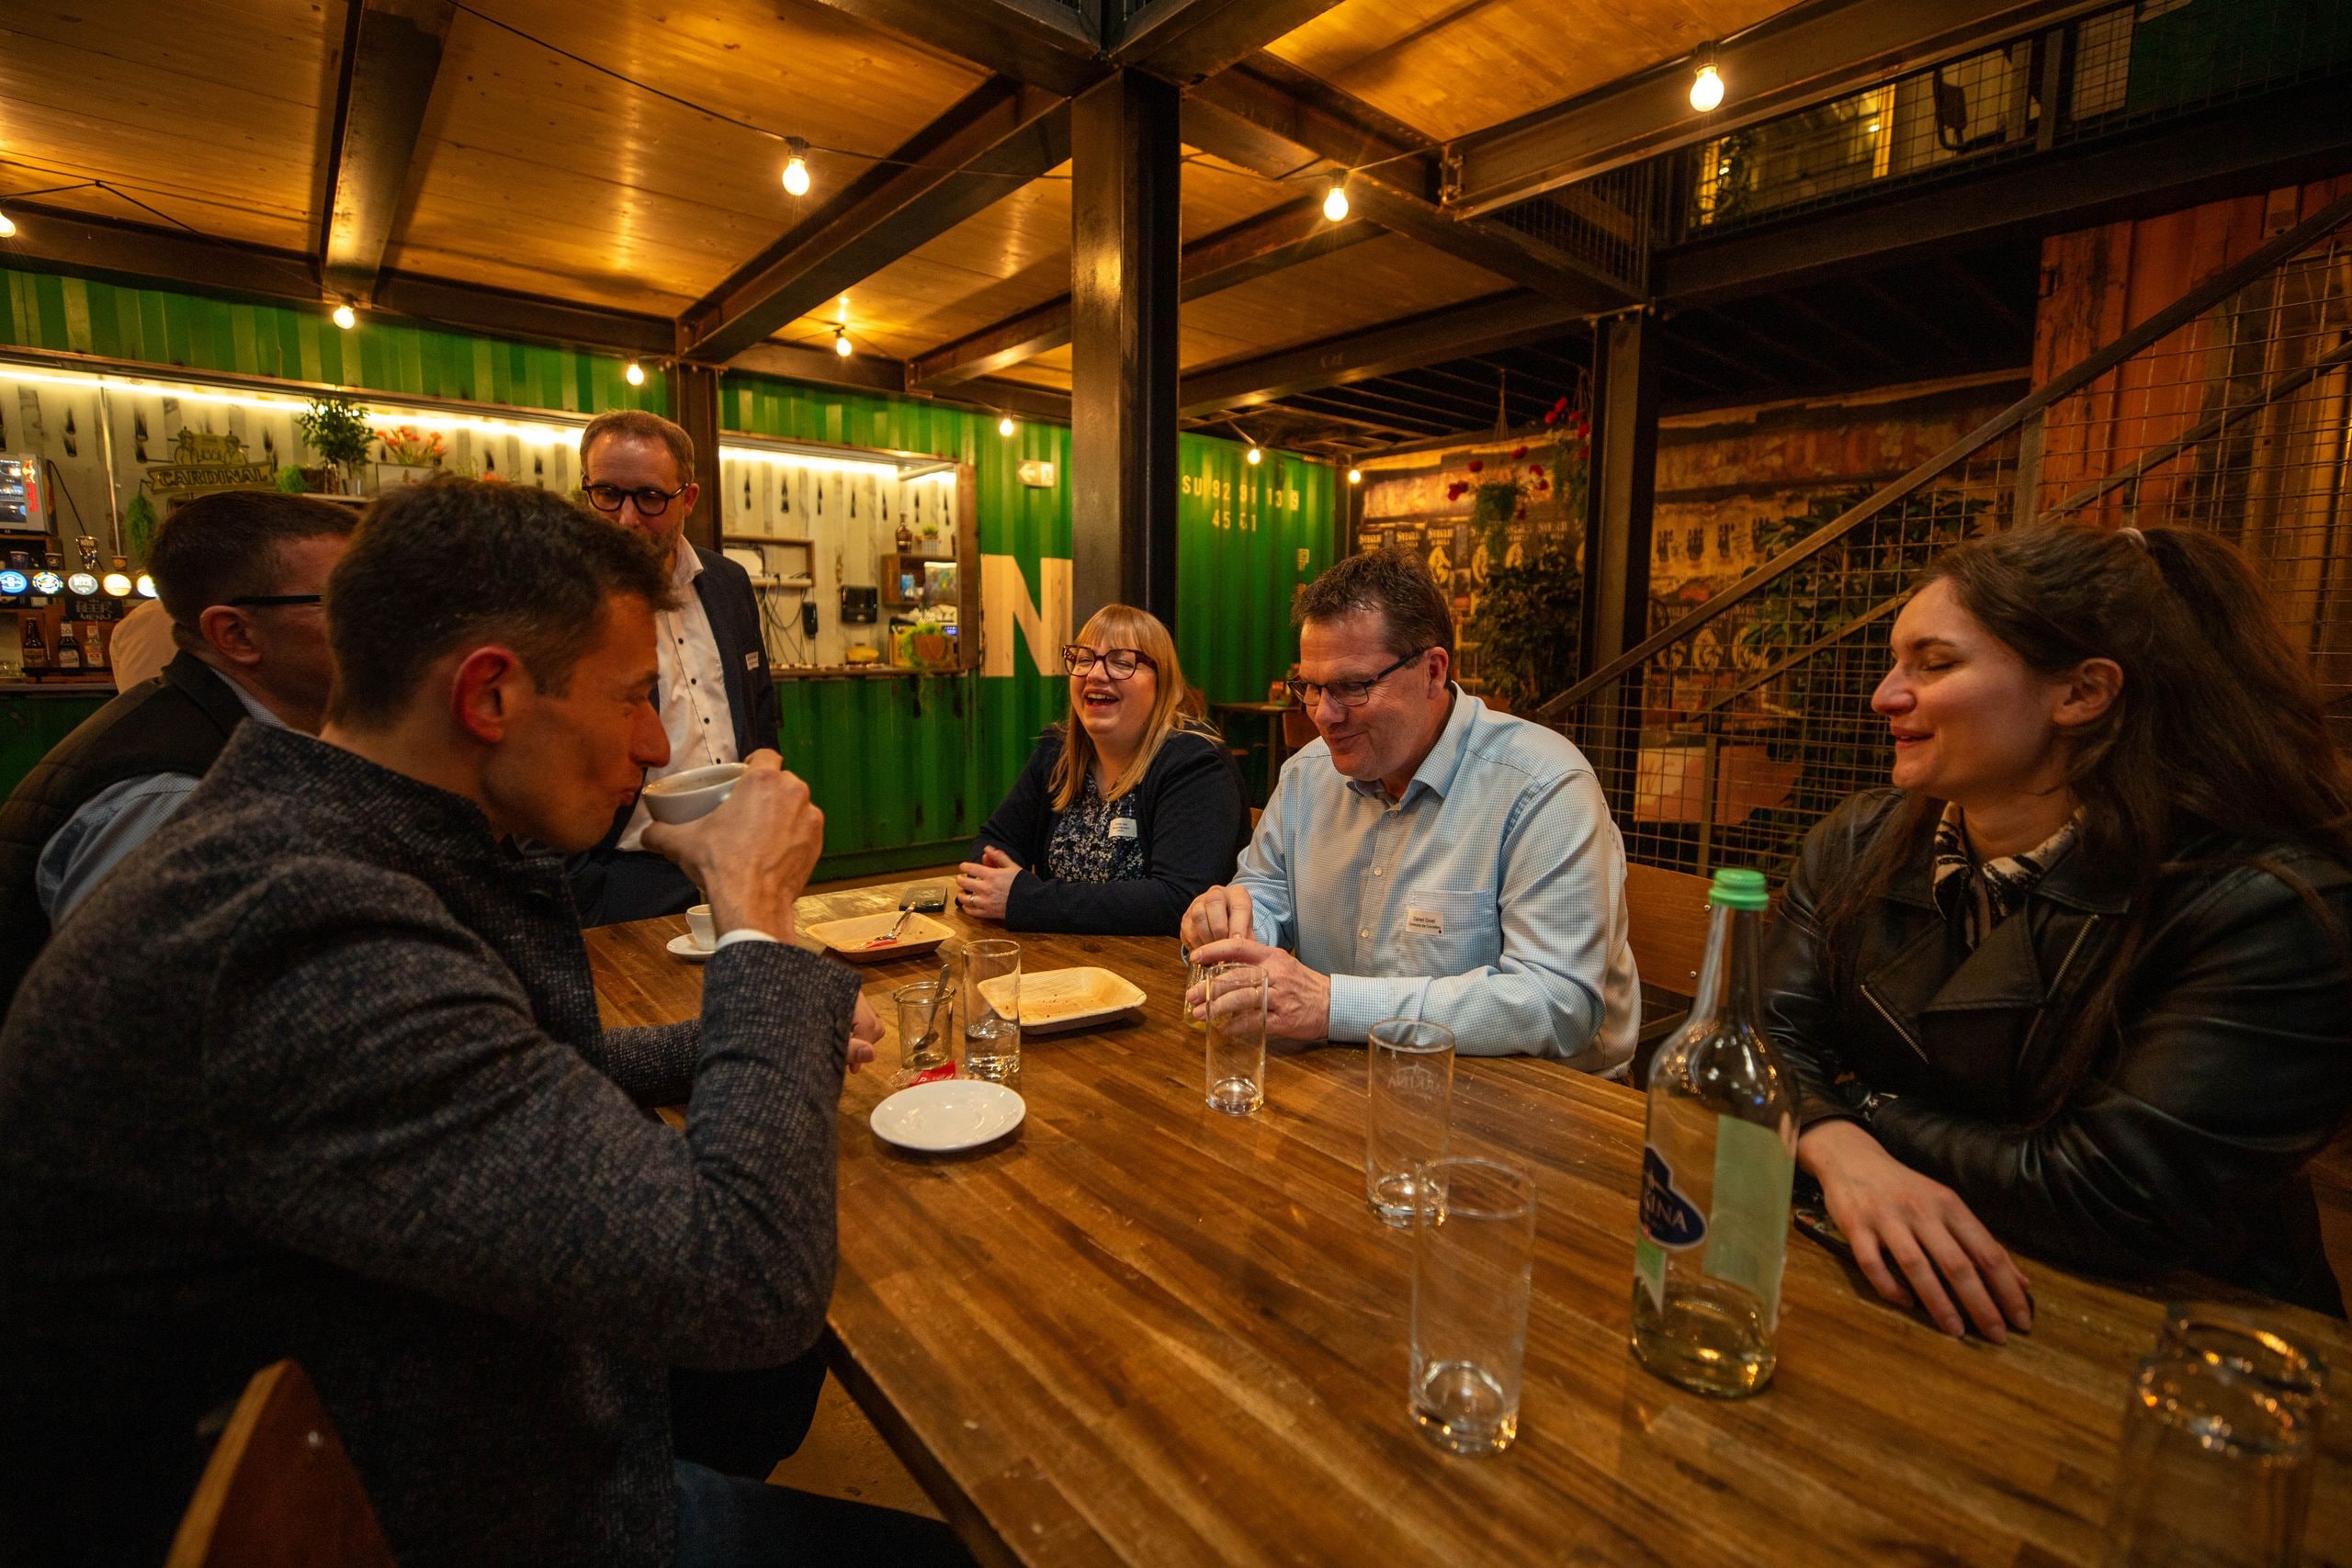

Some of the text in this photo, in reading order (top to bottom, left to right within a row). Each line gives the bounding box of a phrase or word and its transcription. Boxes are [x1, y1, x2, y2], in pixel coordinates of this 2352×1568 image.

[158, 468, 268, 488] CARDINAL
[1212, 509, 1231, 530] 45
[979, 553, 1073, 677] N
[1644, 1190, 1688, 1234] KINA
